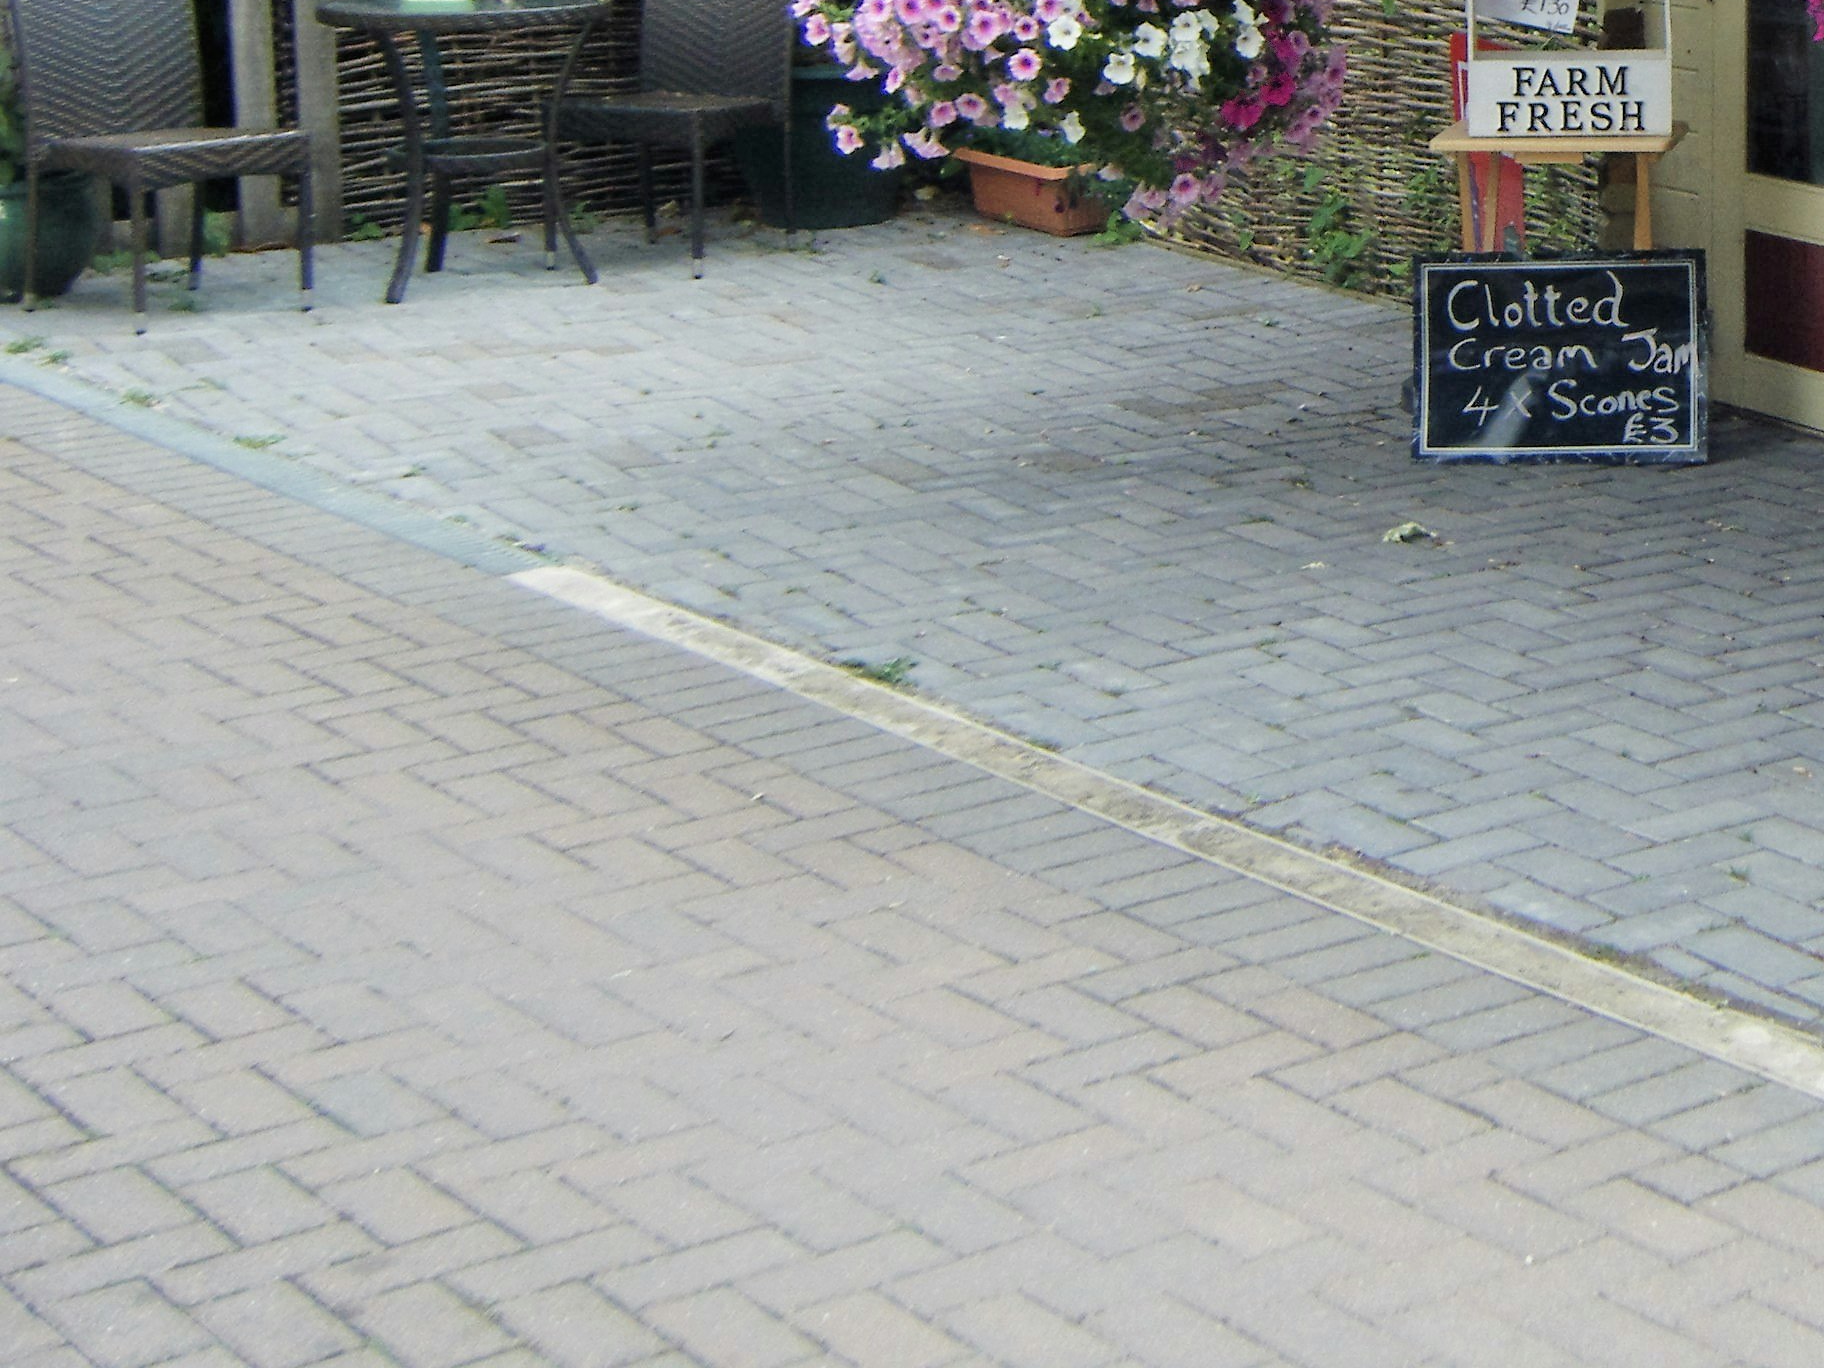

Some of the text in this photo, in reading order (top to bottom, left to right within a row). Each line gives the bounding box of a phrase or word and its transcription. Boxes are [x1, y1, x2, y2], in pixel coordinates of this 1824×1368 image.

[1512, 65, 1630, 98] FARM
[1496, 100, 1647, 134] FRESH
[1448, 270, 1631, 331] Clotted
[1448, 328, 1699, 375] Cream Jam
[1547, 379, 1680, 420] Scones
[1622, 412, 1680, 445] £3
